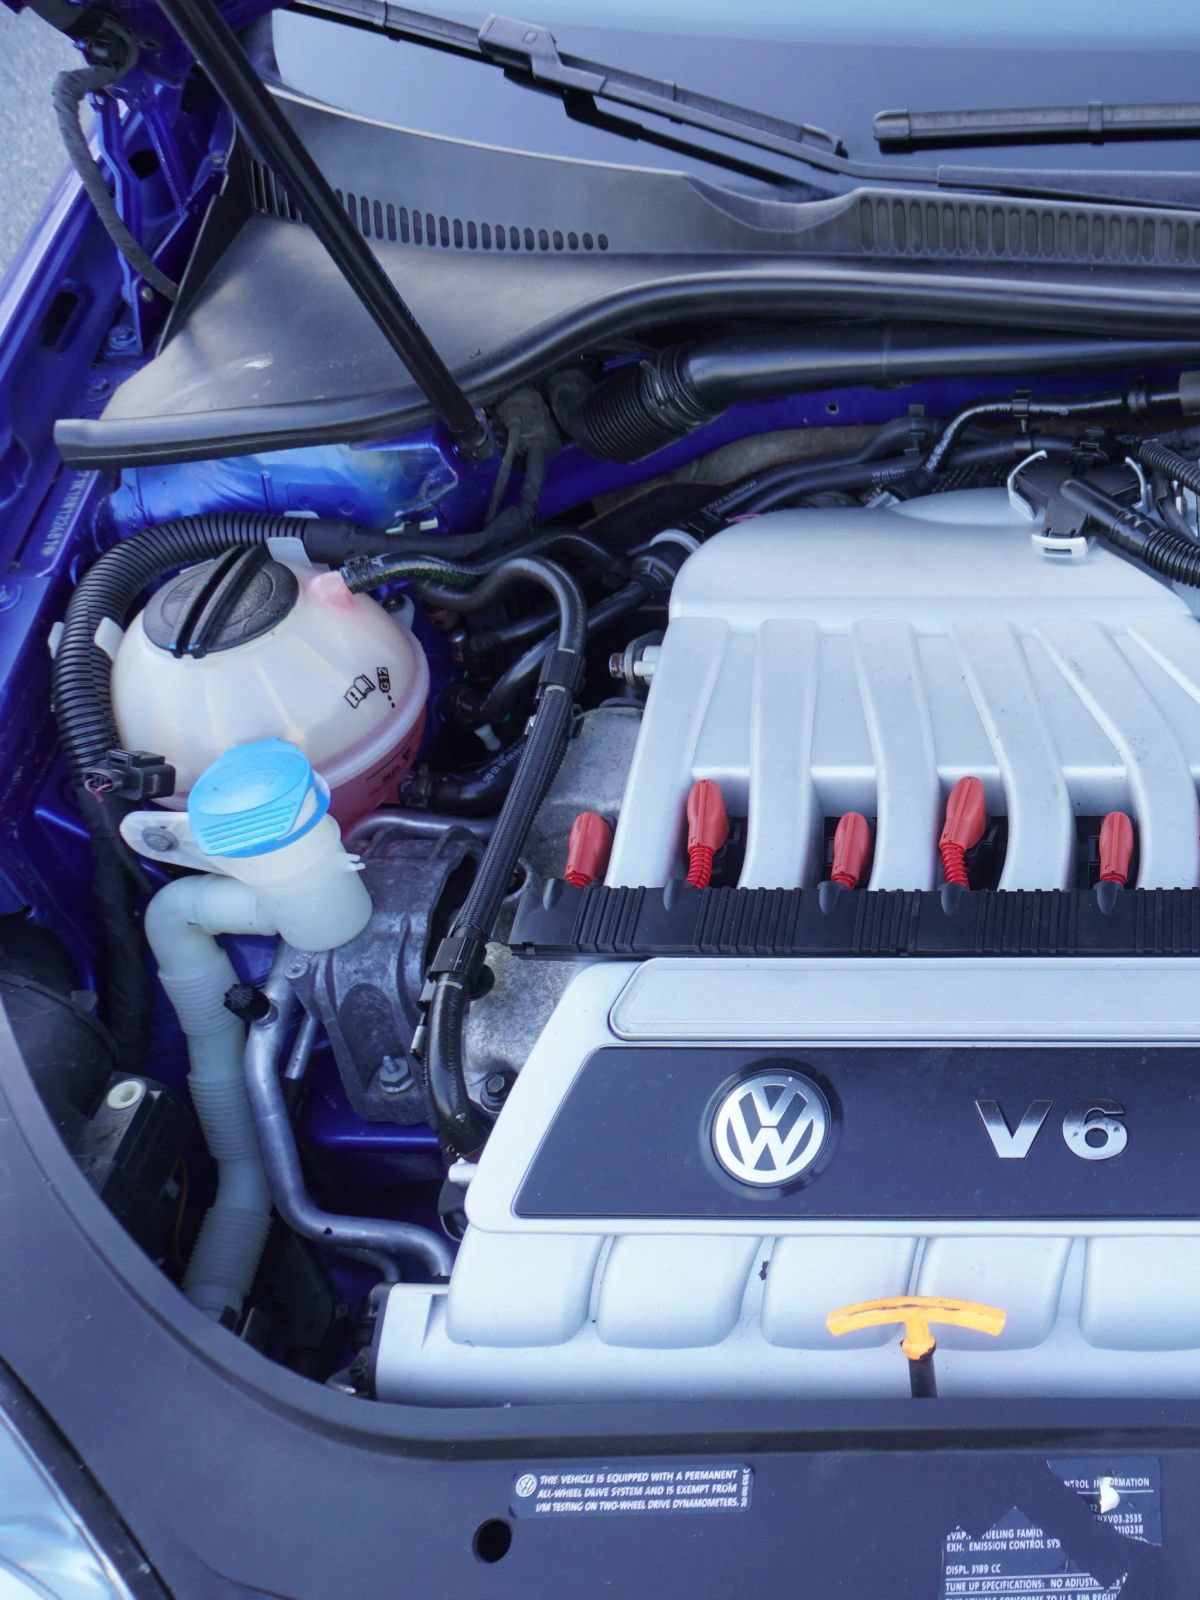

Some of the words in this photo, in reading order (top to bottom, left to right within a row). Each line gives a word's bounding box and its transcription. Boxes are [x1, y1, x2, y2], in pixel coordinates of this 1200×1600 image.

[975, 1099, 1129, 1160] V6
[540, 1474, 559, 1485] THIS
[561, 1473, 595, 1484] VEHICLE
[597, 1473, 604, 1483] IS
[607, 1472, 649, 1484] EQUIPPED
[651, 1471, 674, 1481] WITH
[676, 1471, 683, 1481] A
[685, 1470, 738, 1481] PERMANENT
[537, 1488, 581, 1499] ALL-WHEEL
[584, 1487, 609, 1498] DRIVE
[611, 1486, 642, 1497] SYSTEM
[645, 1486, 665, 1496] AND
[666, 1485, 674, 1495] IS
[676, 1484, 711, 1495] EXEMPT
[712, 1483, 738, 1493] FROM
[536, 1502, 551, 1512] I/M
[552, 1501, 584, 1512] TESTING
[585, 1501, 597, 1511] ON
[600, 1500, 645, 1511] TWO-WHEEL
[647, 1499, 671, 1510] DRIVE
[672, 1497, 739, 1509] DYNAMOMETERS.
[1017, 1527, 1043, 1539] FAMILY
[946, 1542, 965, 1552] EXH.
[969, 1541, 1007, 1551] EMISSION
[1009, 1539, 1045, 1550] CONTROL
[946, 1564, 970, 1575] DISPL.
[971, 1564, 989, 1574] 3189
[991, 1563, 1001, 1573] CC
[945, 1581, 966, 1592] TUNE
[969, 1581, 980, 1591] UP
[981, 1579, 1045, 1591] SPECIFICATIONS:
[1050, 1579, 1063, 1588] NO
